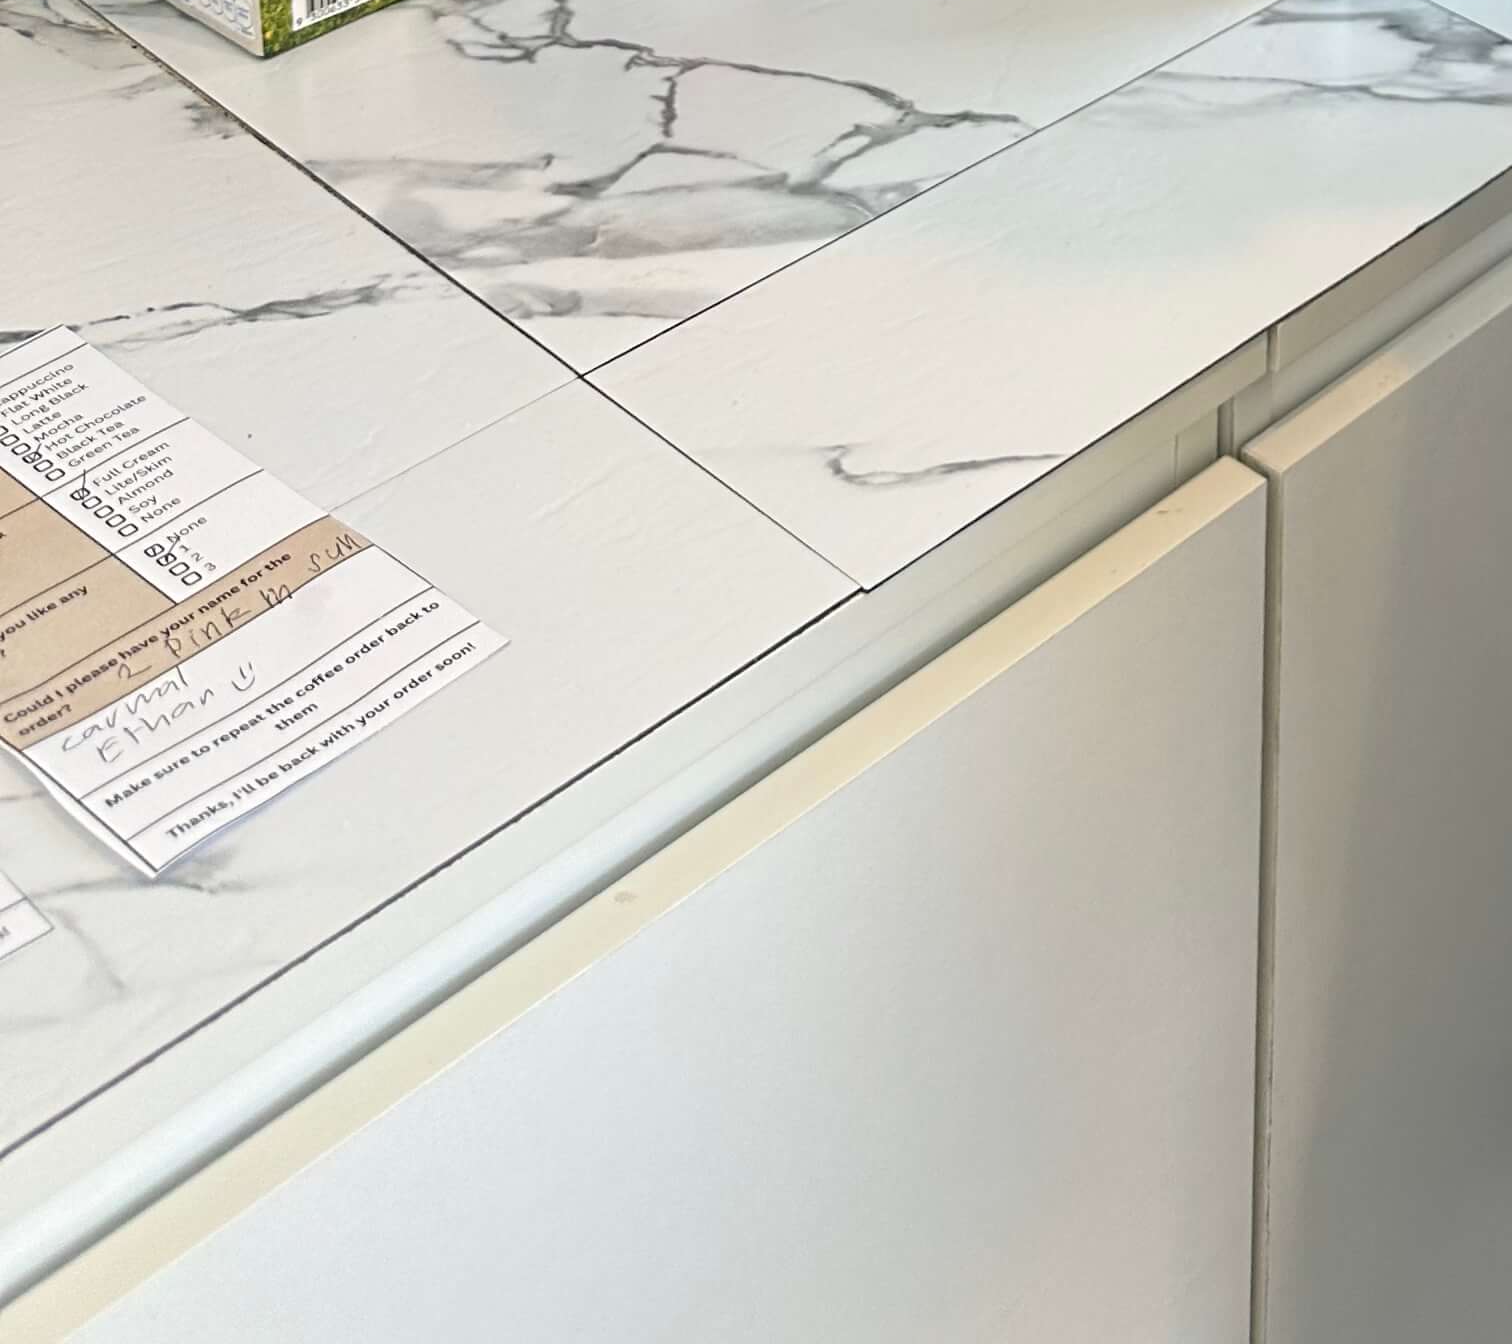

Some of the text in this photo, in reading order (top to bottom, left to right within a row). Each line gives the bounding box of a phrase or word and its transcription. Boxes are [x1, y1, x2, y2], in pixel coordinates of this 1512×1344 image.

[0, 364, 74, 406] appuccino
[0, 378, 73, 418] Flat White
[11, 383, 89, 426] Long Black
[22, 411, 62, 434] Latte
[44, 395, 147, 452] Hot Chocolate
[33, 414, 84, 443] Mocha
[56, 421, 125, 460] Black Tea
[68, 427, 140, 468] Green Tea
[92, 442, 170, 487] Full Cream
[104, 456, 173, 496] Lite/Skim
[118, 469, 174, 505] Almond
[129, 495, 158, 514] Soy
[140, 497, 181, 523] None
[166, 516, 207, 544] None
[179, 544, 191, 553] 1
[191, 552, 203, 562] 2
[204, 562, 216, 572] 3
[26, 601, 57, 622] like
[59, 585, 89, 605] any
[3, 695, 56, 724] Could
[65, 657, 119, 695] please
[118, 634, 160, 661] have
[160, 613, 196, 639] your
[197, 585, 241, 614] name
[241, 569, 266, 588] for
[265, 552, 292, 574] the
[18, 703, 73, 738] order?
[104, 601, 441, 808] Make sure to repeat the coffee order back to
[274, 702, 320, 732] them
[96, 688, 216, 764] Ethan
[165, 641, 478, 839] Thanks, I'll be back with your order soon!
